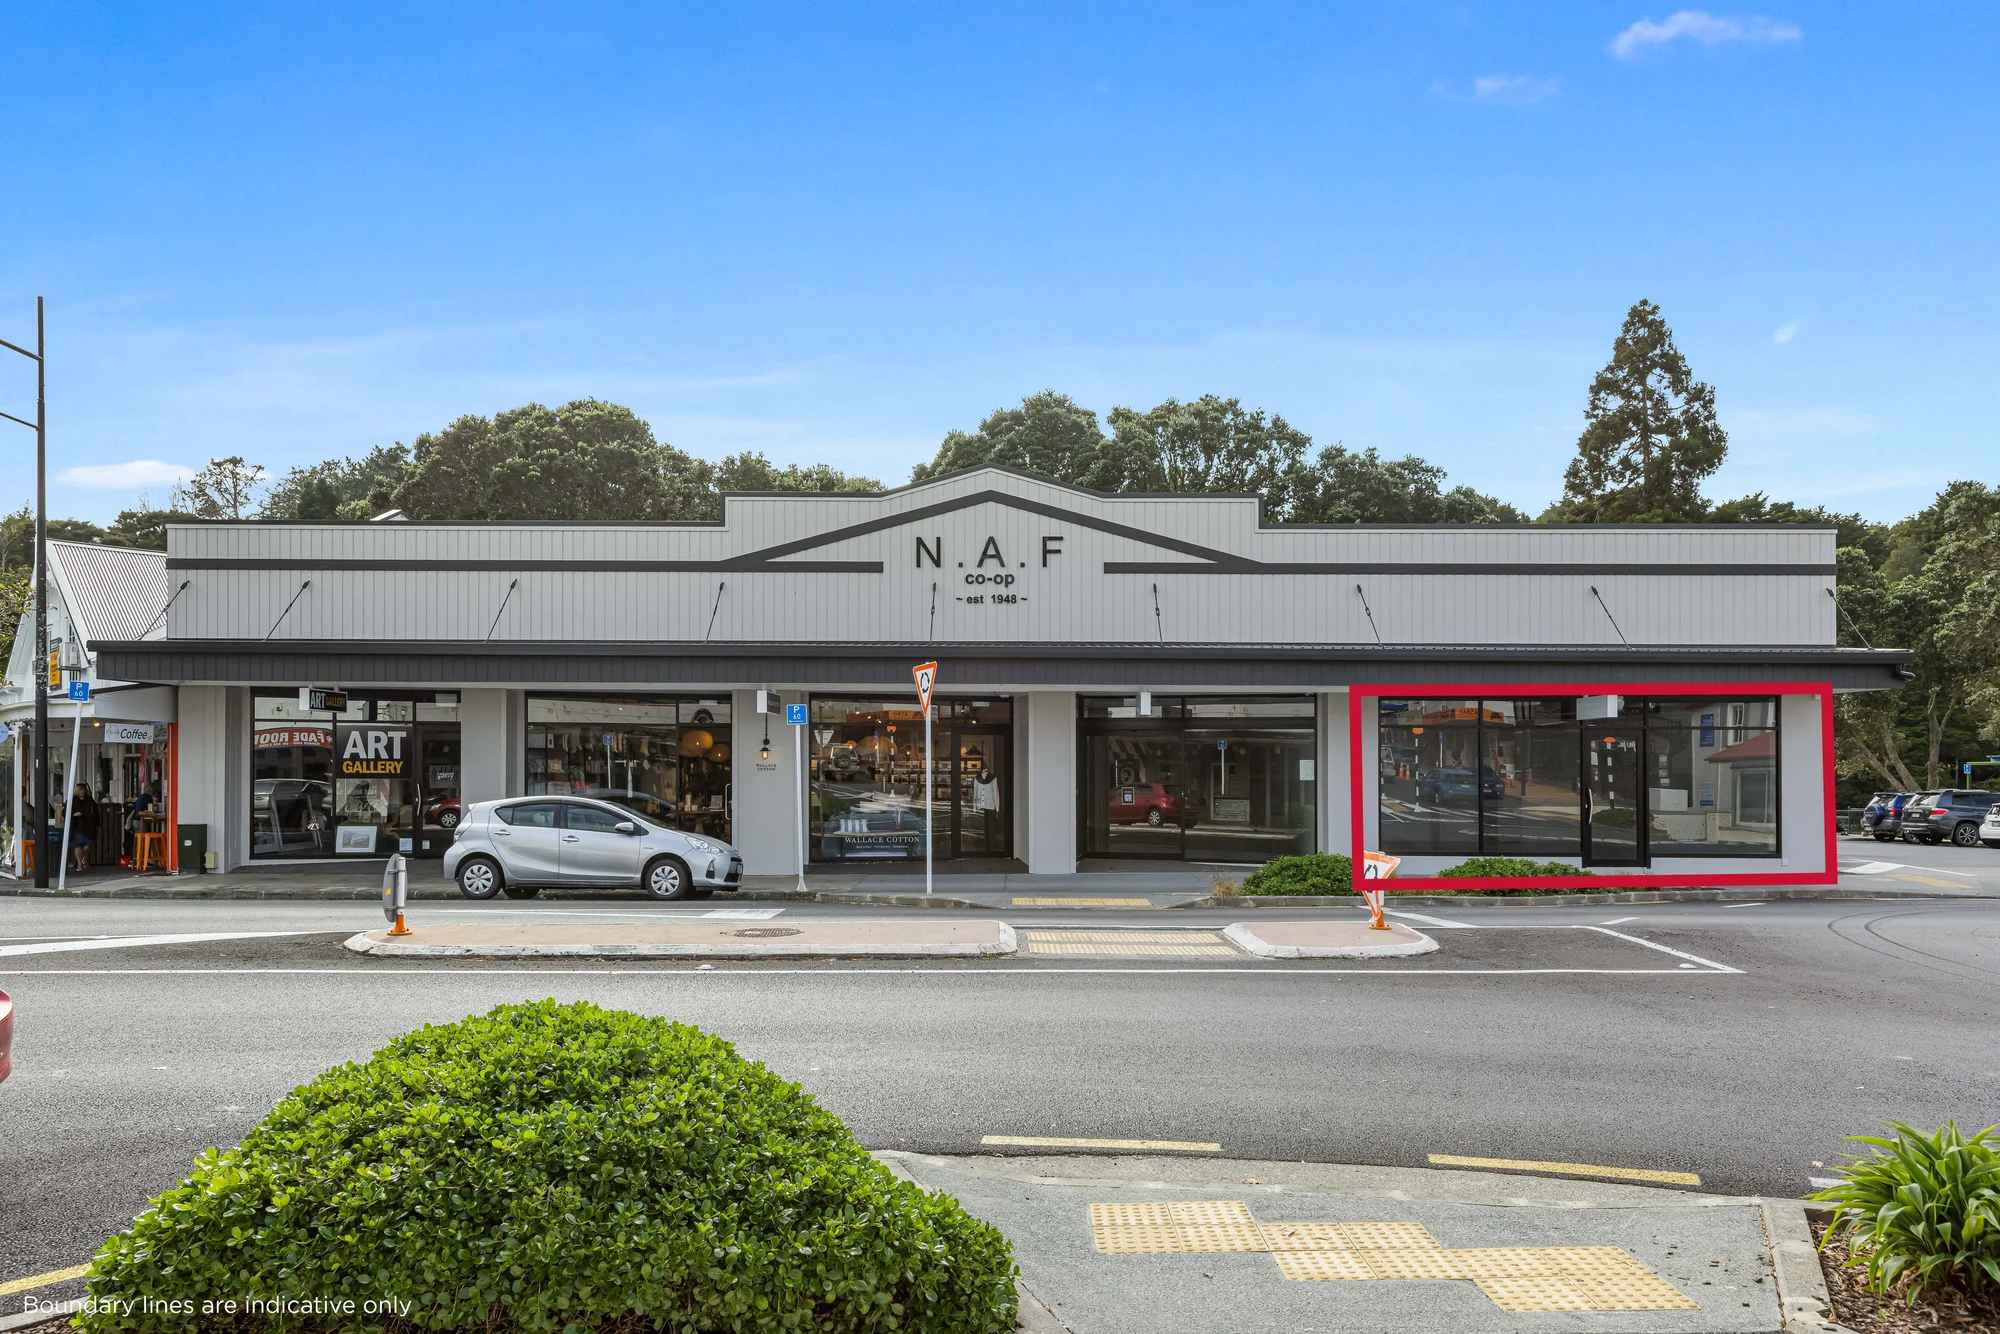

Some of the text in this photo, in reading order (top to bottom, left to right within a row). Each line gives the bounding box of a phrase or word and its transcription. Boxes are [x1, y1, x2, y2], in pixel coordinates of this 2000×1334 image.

[965, 573, 1015, 588] co-op
[991, 594, 1017, 604] 1948
[310, 692, 346, 709] ART GALLERY
[793, 706, 800, 714] P
[120, 728, 148, 740] Coffee
[342, 730, 407, 760] ART
[342, 761, 404, 774] GALLERY
